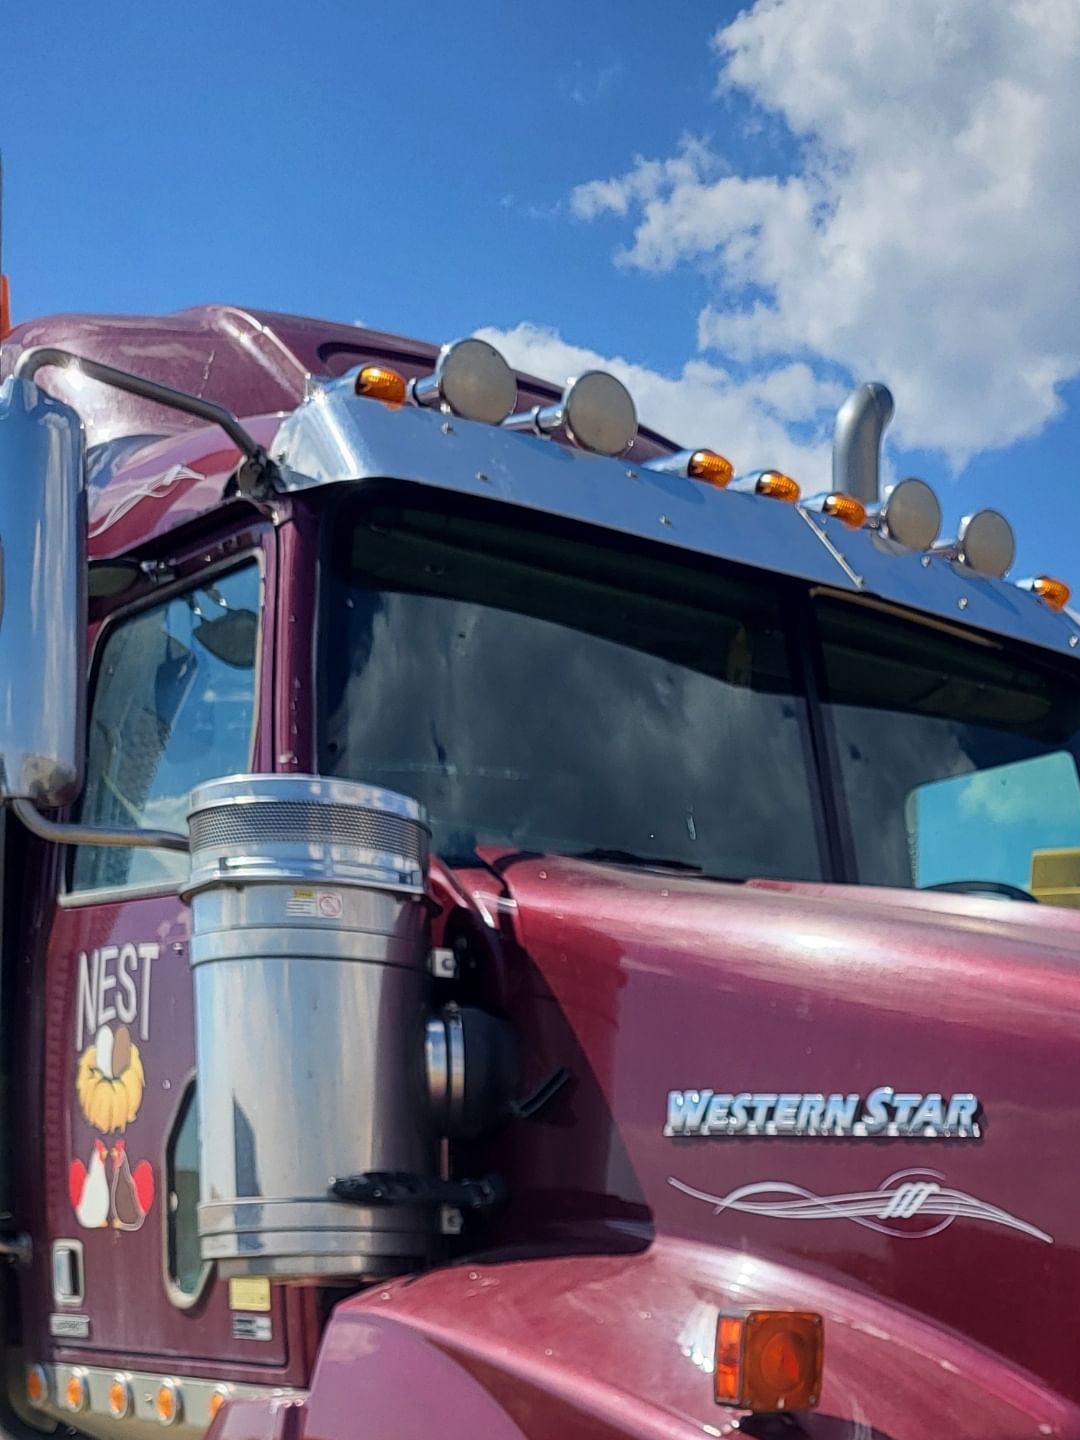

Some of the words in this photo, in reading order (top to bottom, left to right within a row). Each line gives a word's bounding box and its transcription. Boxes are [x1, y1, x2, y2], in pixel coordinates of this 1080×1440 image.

[76, 942, 160, 1052] NEST
[664, 1088, 859, 1137] WESTERN
[853, 1086, 982, 1137] STAR
